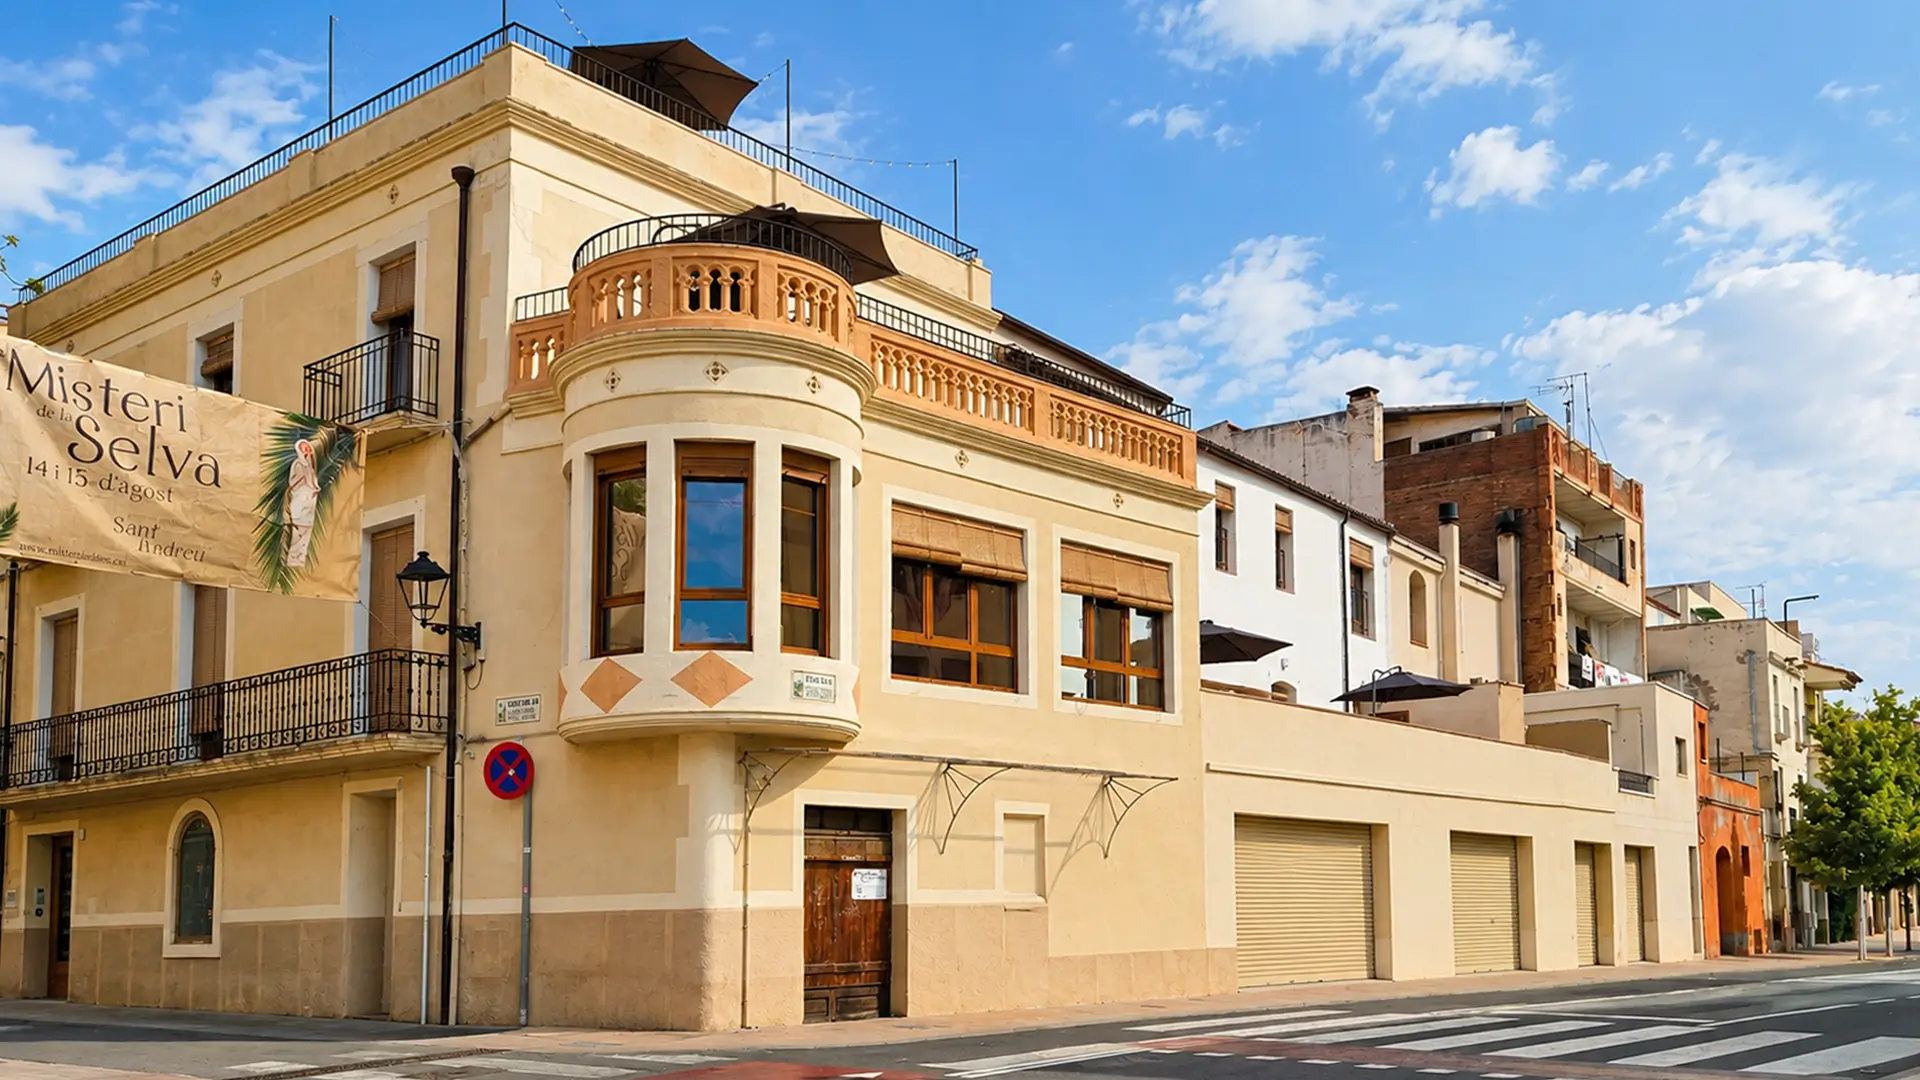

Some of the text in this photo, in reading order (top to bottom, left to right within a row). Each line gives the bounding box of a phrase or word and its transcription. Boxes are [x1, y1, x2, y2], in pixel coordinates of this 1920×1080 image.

[6, 348, 187, 433] Misteri
[36, 405, 72, 422] de la
[67, 414, 222, 489] Selva
[27, 456, 48, 477] 14
[68, 467, 89, 488] 15
[98, 473, 173, 503] d'agost
[113, 516, 160, 539] Sant
